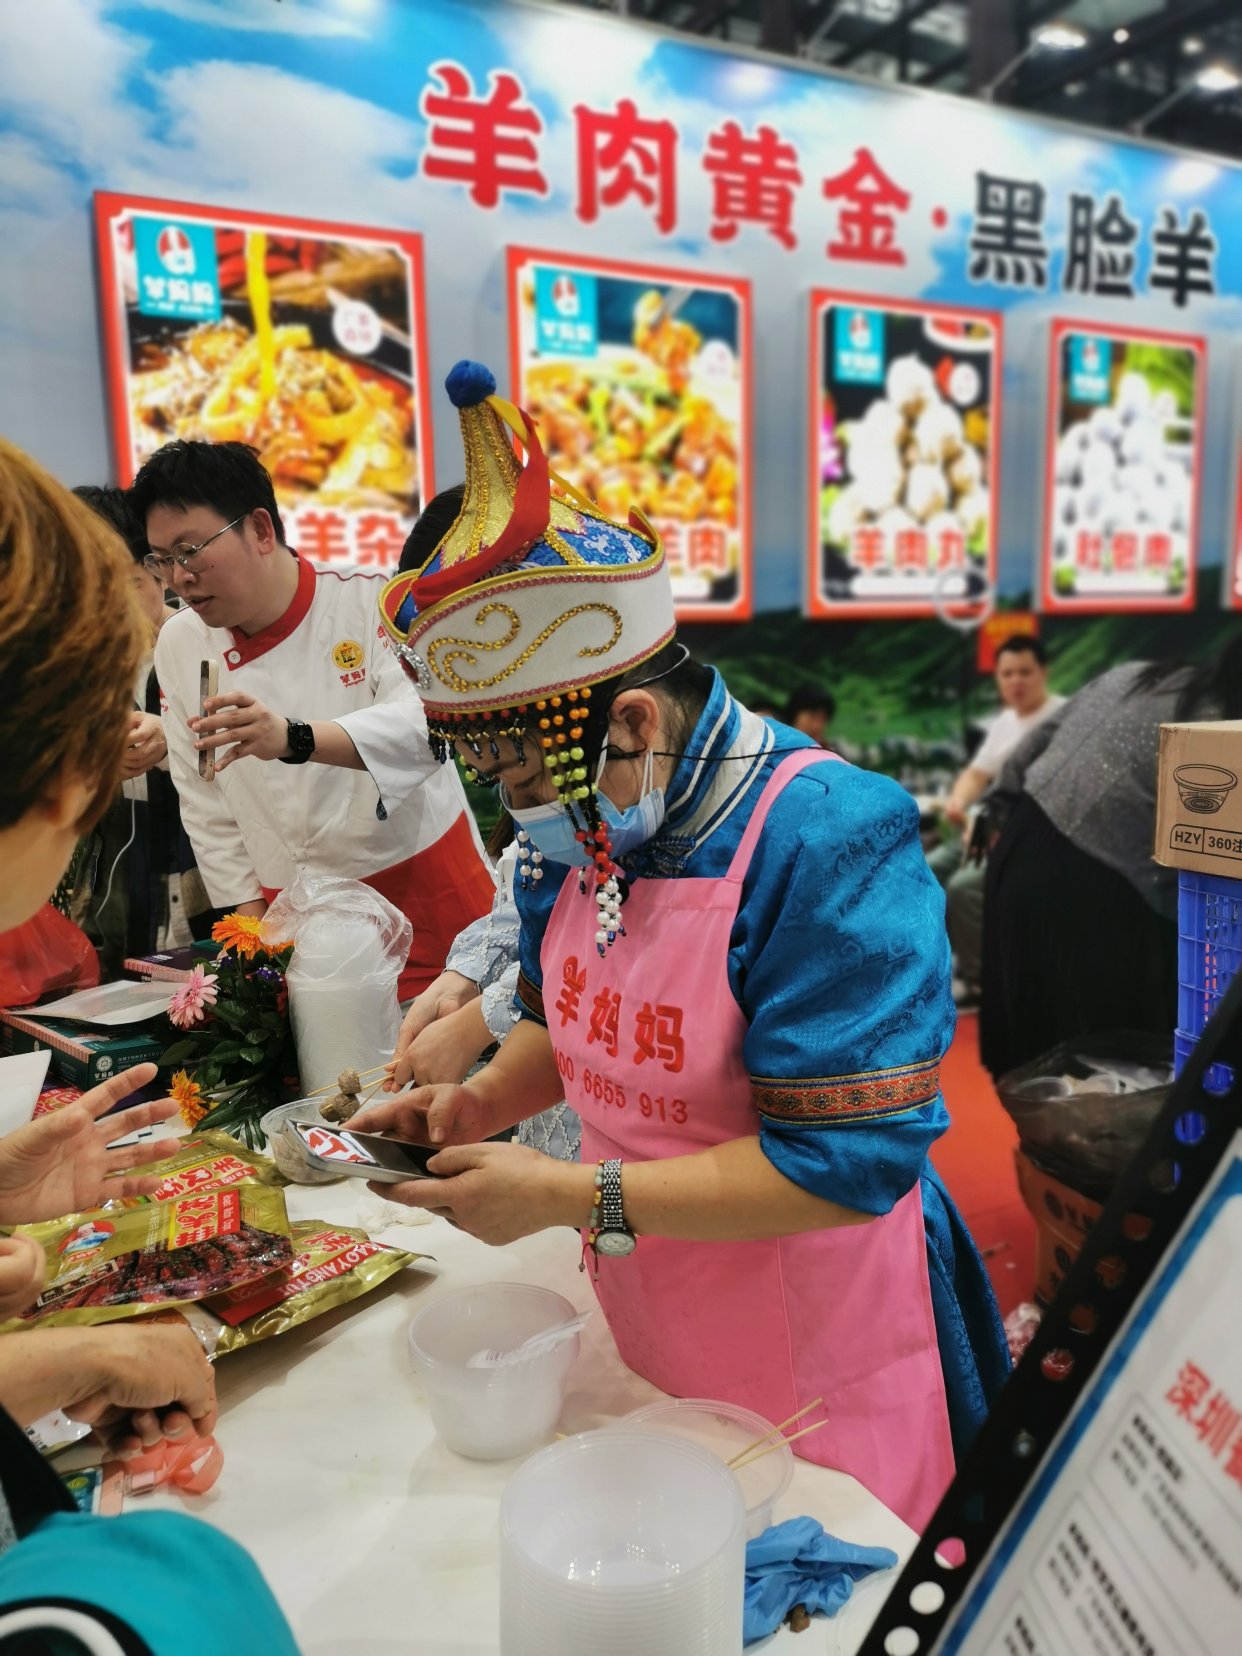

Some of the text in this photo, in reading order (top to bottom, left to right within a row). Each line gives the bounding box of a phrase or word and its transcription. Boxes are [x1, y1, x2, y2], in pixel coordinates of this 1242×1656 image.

[284, 511, 406, 567] 羊杂
[1174, 830, 1202, 846] HZY
[555, 955, 685, 1074] 羊妈妈
[583, 1067, 627, 1109] 6655
[638, 1092, 689, 1124] 913
